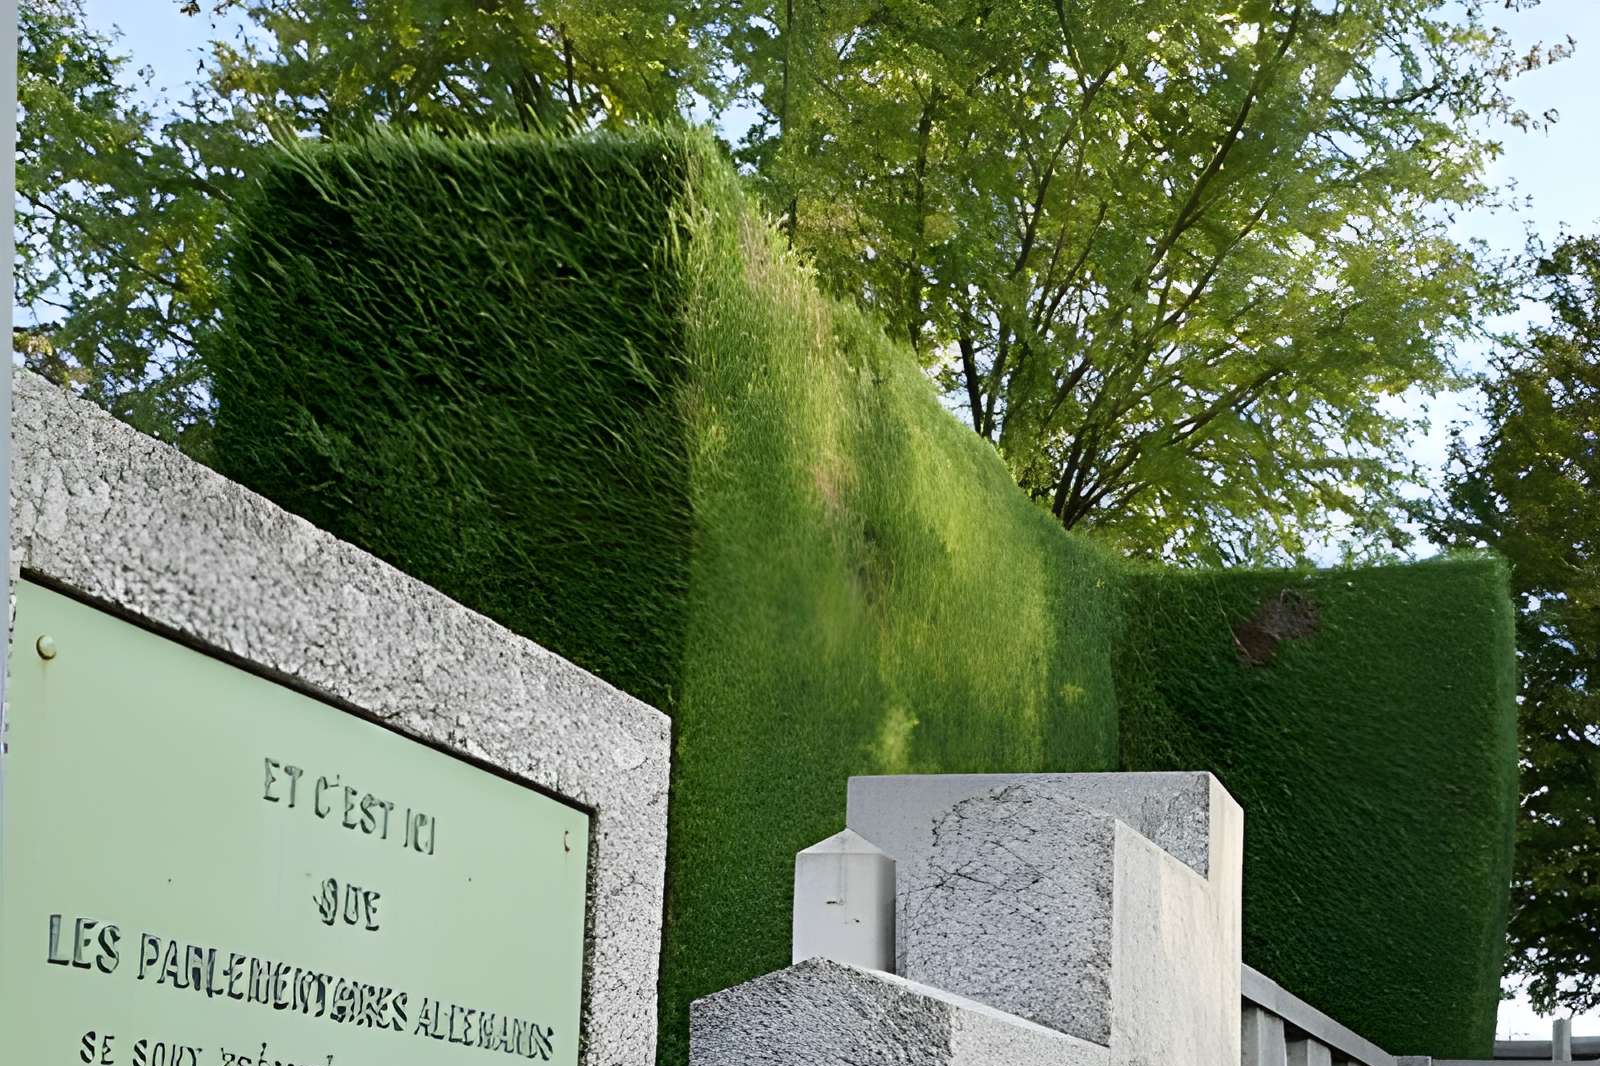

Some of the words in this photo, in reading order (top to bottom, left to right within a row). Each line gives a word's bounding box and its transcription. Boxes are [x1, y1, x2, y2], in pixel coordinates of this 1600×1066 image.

[264, 757, 304, 808] ET
[314, 775, 394, 840] C'EST
[405, 807, 436, 855] ICI
[47, 914, 121, 973] LES
[80, 1031, 115, 1065] SE
